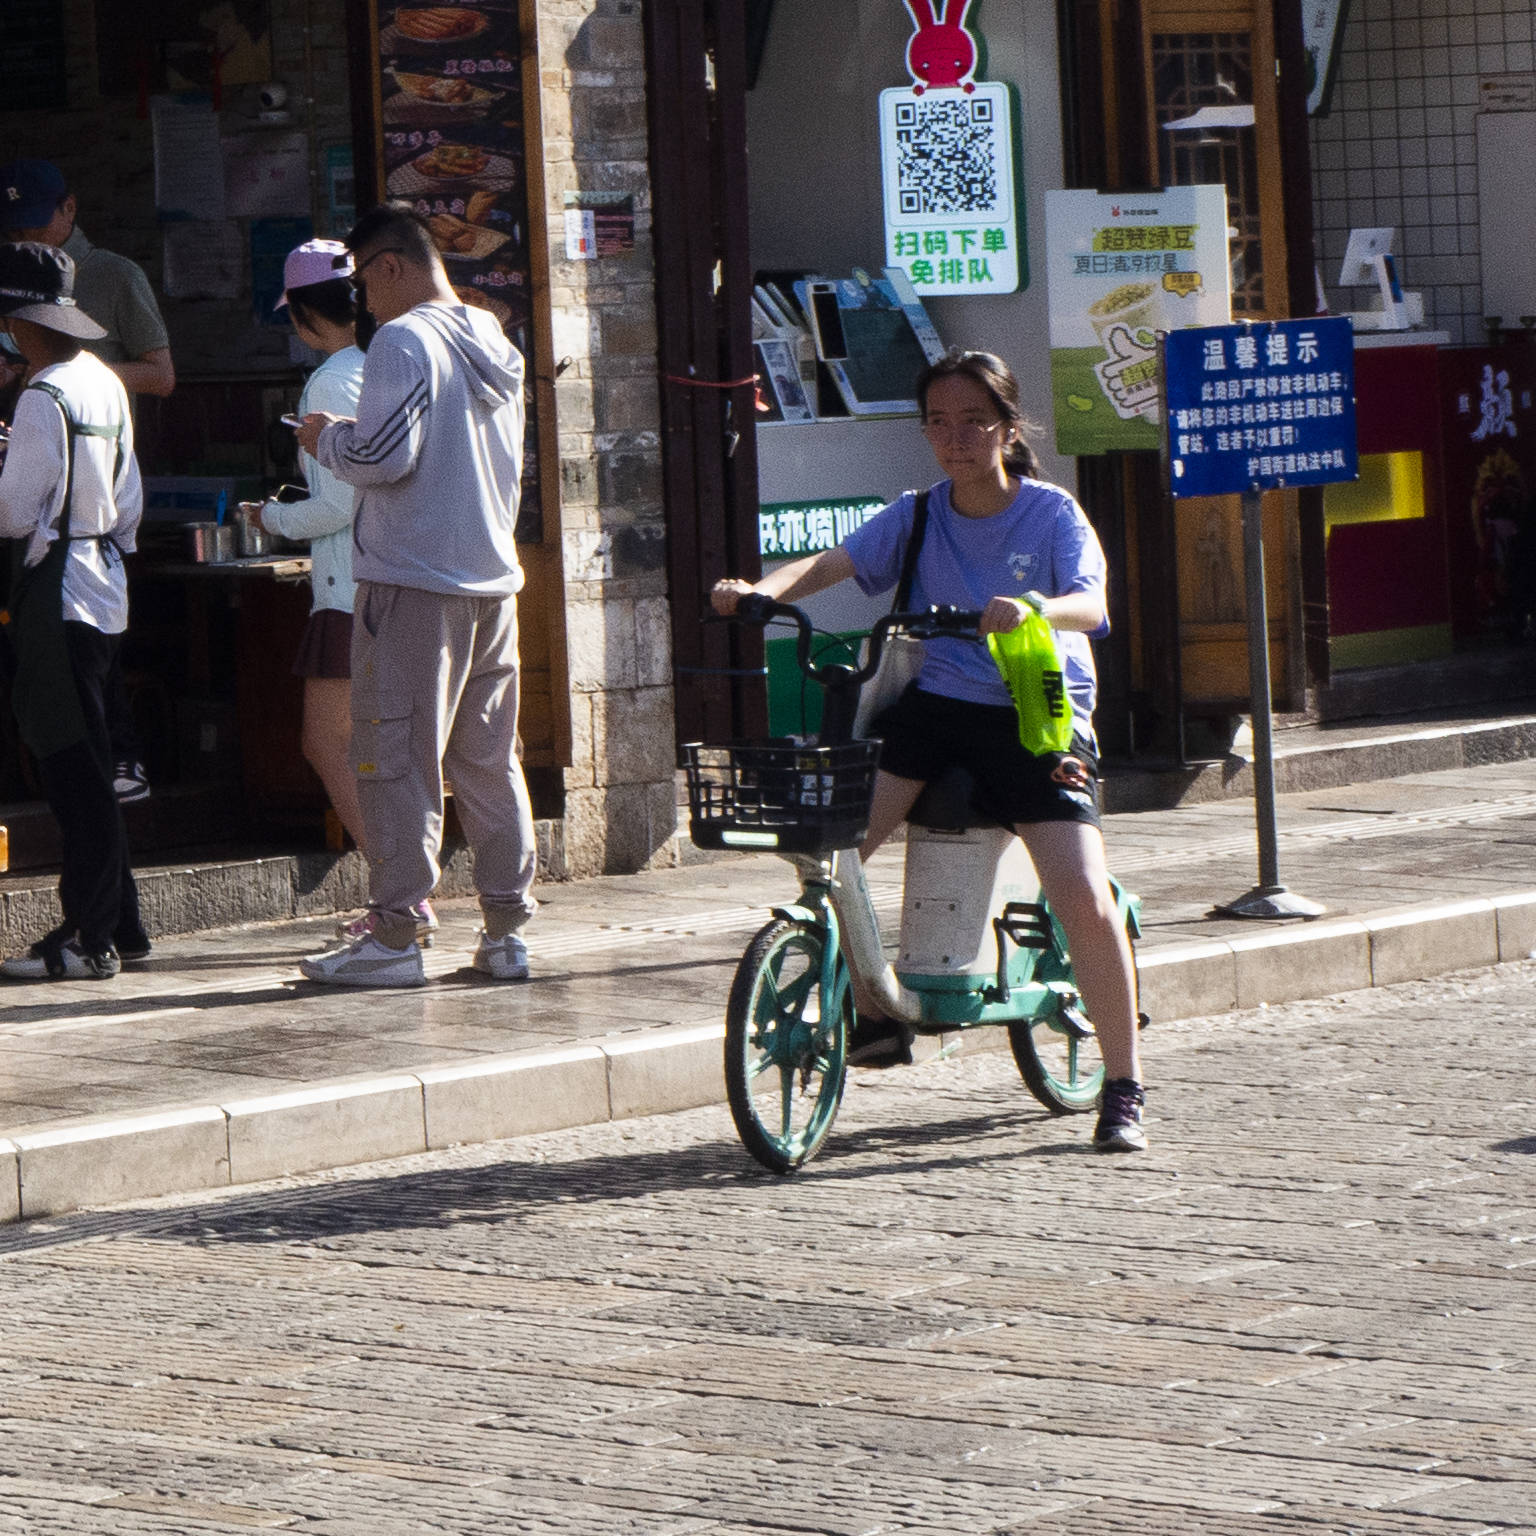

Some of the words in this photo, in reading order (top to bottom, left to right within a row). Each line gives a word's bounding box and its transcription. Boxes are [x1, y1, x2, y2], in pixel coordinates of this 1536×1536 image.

[893, 227, 1007, 257] 扫码下单
[1100, 225, 1195, 252] 超赞绿豆
[909, 258, 993, 285] 免排队
[1073, 252, 1179, 276] 夏日清凉救星
[1202, 331, 1319, 372] 温馨提示
[1247, 448, 1347, 477] 护国街道执法中队
[758, 503, 888, 556] 书亦烧仙
